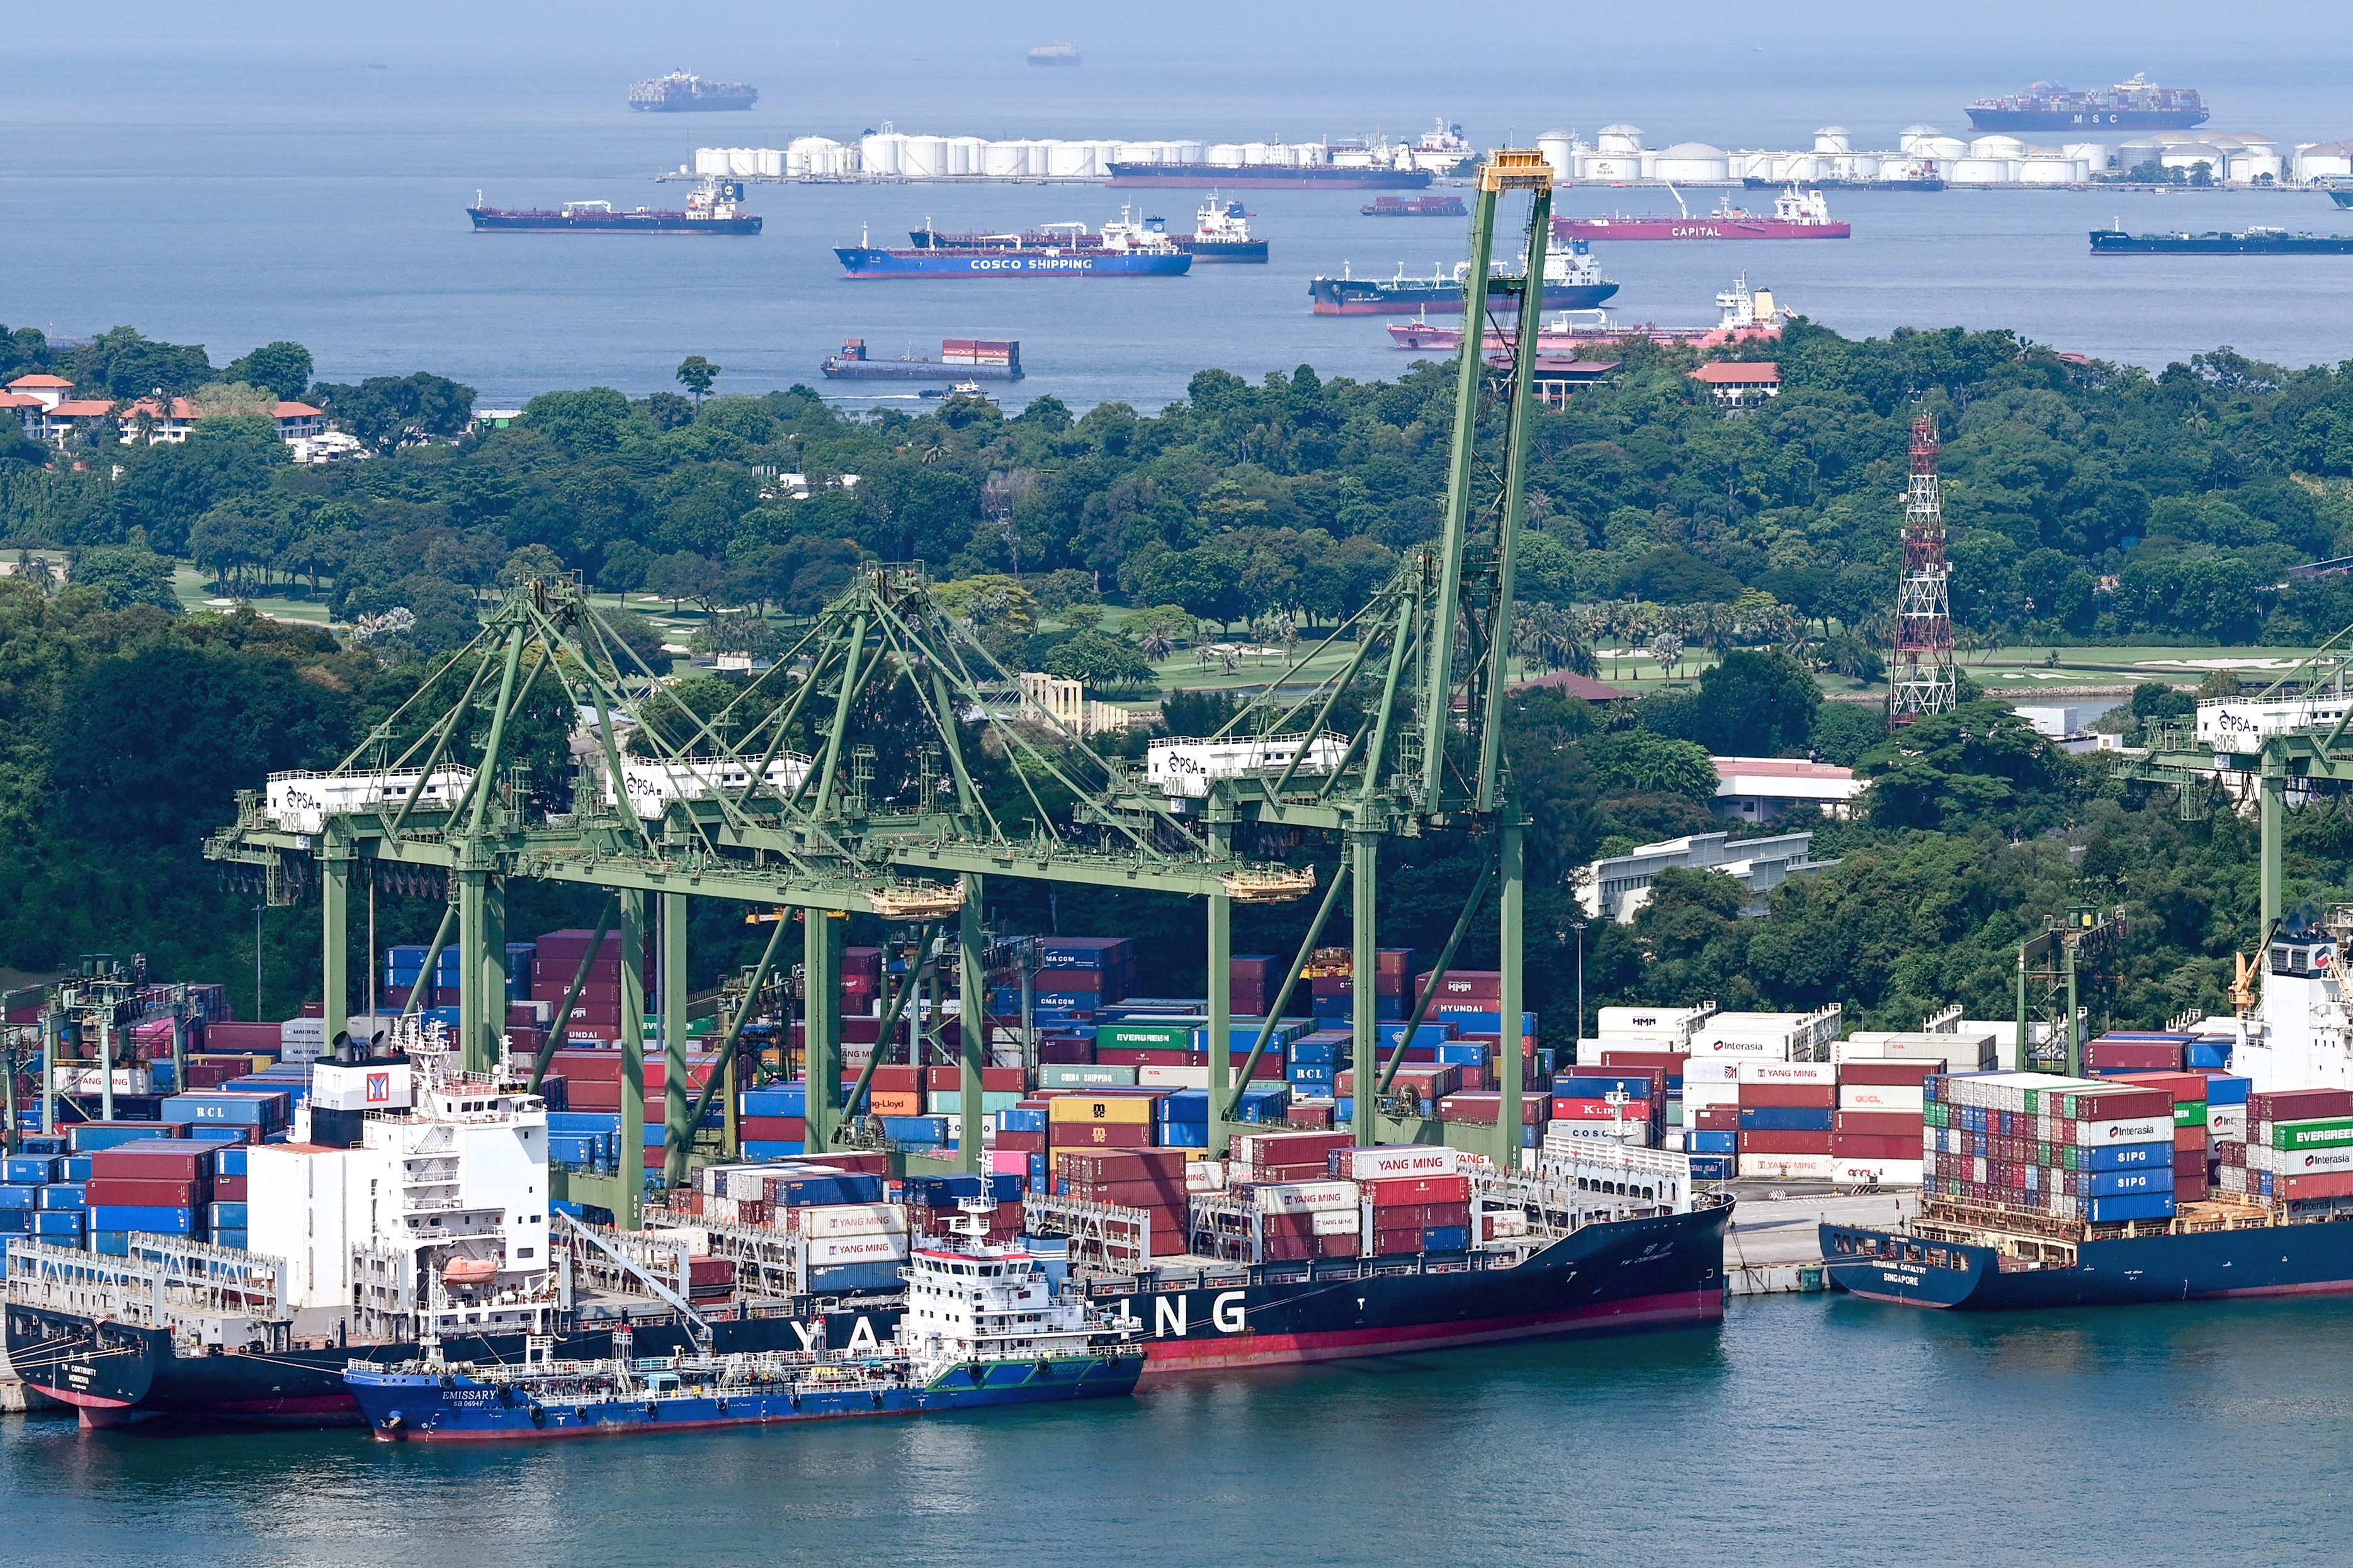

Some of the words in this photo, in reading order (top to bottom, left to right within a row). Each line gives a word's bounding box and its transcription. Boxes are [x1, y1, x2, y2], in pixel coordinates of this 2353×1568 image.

[1672, 227, 1725, 237] CAPITAL
[970, 260, 1021, 269] COSCO
[1028, 259, 1093, 269] SHIPPING
[2231, 716, 2251, 733] PSA
[1181, 757, 1198, 774] PSA
[637, 779, 655, 796] PSA
[297, 792, 315, 809] PSA
[1448, 981, 1471, 993] HMM
[1633, 1017, 1656, 1027] HMM
[1117, 1034, 1169, 1042] EVERGREEN
[1724, 1042, 1762, 1051] Interasia
[1061, 1073, 1079, 1083] CHINA
[1084, 1073, 1112, 1083] SHIPPING
[1296, 1069, 1322, 1078] RCL
[196, 1107, 224, 1118] RCL
[2119, 1125, 2154, 1136] Interasia
[2296, 1128, 2353, 1142] EVERGREE
[2118, 1152, 2146, 1162] SIPG
[2315, 1153, 2349, 1165] Interasia
[1378, 1159, 1409, 1171] YANG
[1413, 1157, 1443, 1168] MING
[2118, 1176, 2146, 1187] SIPG
[1294, 1195, 1316, 1204] YANG
[1318, 1193, 1341, 1202] MING
[840, 1217, 864, 1226] YANG
[866, 1216, 889, 1225] MING
[840, 1244, 863, 1254] YANG
[866, 1243, 888, 1252] MING
[1900, 1263, 1927, 1274] CATALYST
[1883, 1273, 1919, 1286] SINGAPORE
[443, 1390, 496, 1400] EMISSARY
